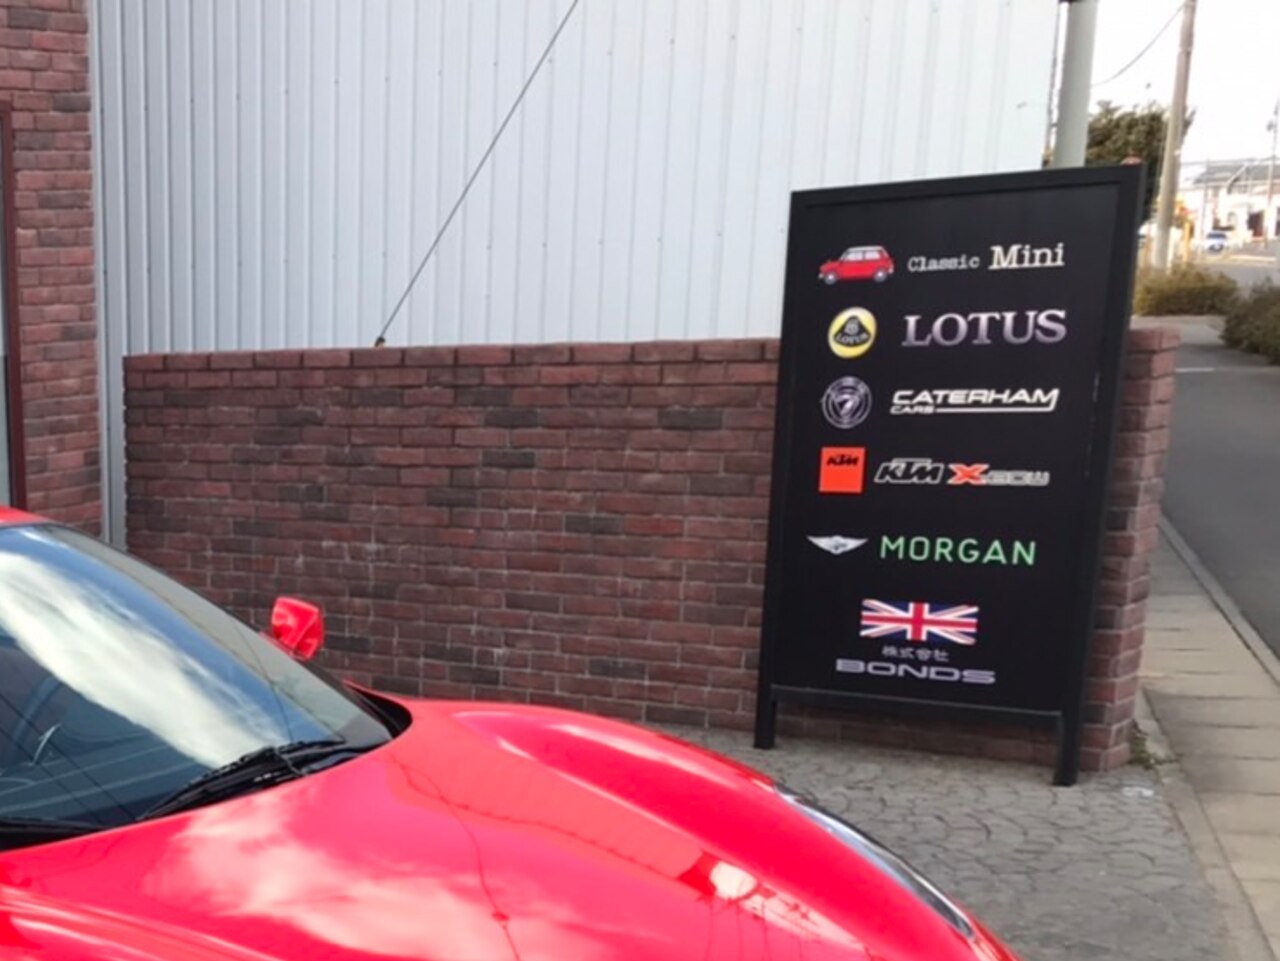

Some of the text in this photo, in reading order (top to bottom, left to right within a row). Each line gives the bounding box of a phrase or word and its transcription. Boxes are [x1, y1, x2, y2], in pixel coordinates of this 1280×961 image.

[907, 242, 1065, 273] Classic Mini
[901, 309, 1068, 347] LOTUS
[890, 405, 935, 415] CARS
[892, 388, 1061, 405] CATERHAM
[826, 453, 860, 467] KTM
[873, 457, 945, 485] KTM
[879, 535, 1037, 566] MORGAN
[835, 658, 997, 685] BONDS
